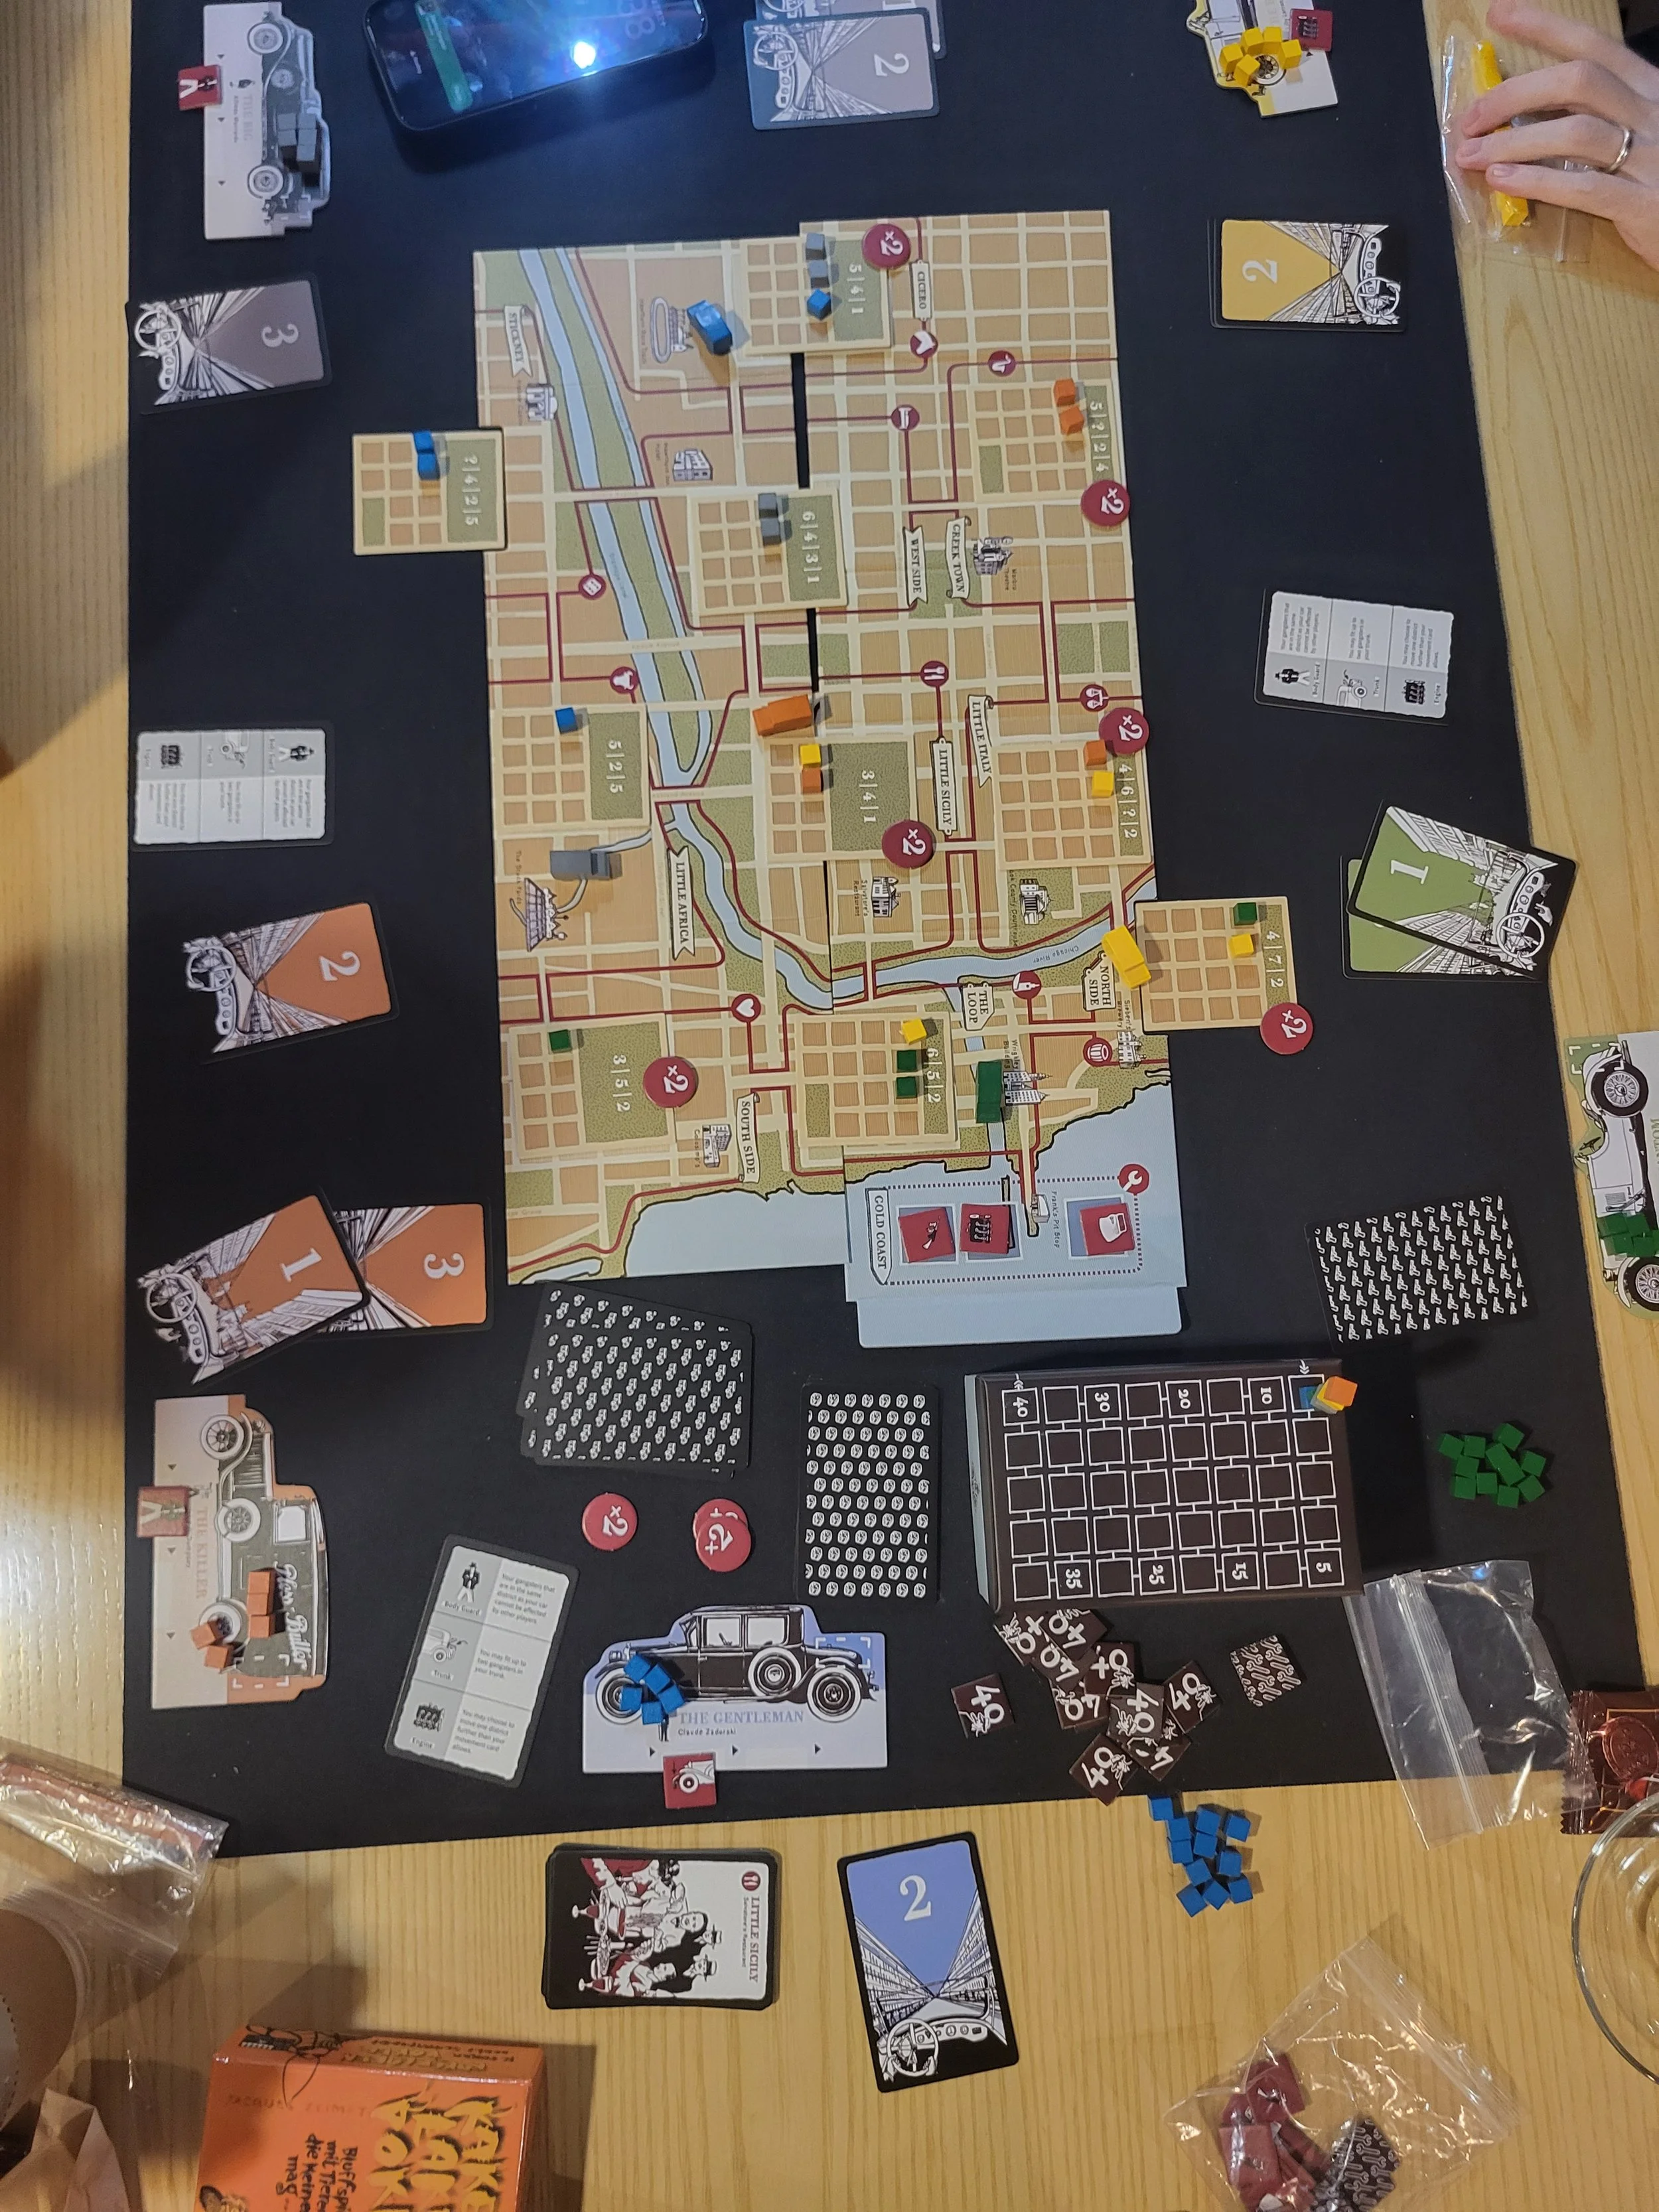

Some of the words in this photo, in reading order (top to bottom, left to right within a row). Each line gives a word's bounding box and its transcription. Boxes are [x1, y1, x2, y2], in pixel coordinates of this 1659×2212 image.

[873, 52, 910, 77] 2
[1242, 259, 1278, 283] 2
[918, 271, 927, 310] CICERO
[261, 323, 299, 348] 3
[510, 313, 524, 364] STICKNEY
[911, 538, 920, 565] WEST
[952, 524, 962, 558] GREEK
[912, 568, 922, 593] SIDE
[955, 560, 965, 593] TOWN
[972, 701, 984, 743] LITTLE
[979, 745, 992, 774] ITALY
[939, 749, 949, 786] LITTLE
[942, 789, 952, 825] SICILY
[676, 862, 685, 899] LITTLE
[1389, 857, 1429, 884] 1
[678, 901, 689, 944] AFRICA
[1033, 954, 1050, 963] River
[1052, 945, 1079, 957] Chicago
[319, 951, 361, 982] 2
[1089, 978, 1099, 1006] SIDE
[1100, 966, 1111, 1007] NORTH
[968, 990, 977, 1023] LOOP
[979, 990, 987, 1015] THE
[1003, 1040, 1011, 1069] Building
[1011, 1039, 1020, 1069] Wrigley
[741, 1100, 753, 1143] SOUTH
[745, 1145, 756, 1174] SIDE
[876, 1231, 887, 1269] COAST
[280, 1248, 323, 1282] 1
[423, 1252, 465, 1280] 3
[1013, 1396, 1029, 1418] 40
[1094, 1392, 1111, 1413] 30
[1178, 1388, 1192, 1410] 20
[1260, 1386, 1273, 1405] 10
[1064, 1568, 1083, 1590] 35
[1149, 1564, 1166, 1585] 25
[1231, 1562, 1249, 1581] 15
[1315, 1562, 1332, 1574] 5
[444, 1600, 459, 1611] Body
[461, 1605, 480, 1615] Guard
[433, 1669, 452, 1680] Trunk
[972, 1684, 1005, 1726] 40
[1169, 1672, 1200, 1712] 40
[678, 1711, 709, 1726] THE
[713, 1710, 805, 1725] GENTLEMAN
[1127, 1688, 1159, 1733] 40
[411, 1736, 433, 1749] Engine
[678, 1727, 703, 1737] Claude
[1081, 1746, 1115, 1789] 40
[899, 1874, 933, 1922] 2
[751, 1896, 760, 1939] LITTLE
[749, 1943, 759, 1982] SICILY
[305, 2133, 324, 2159] die
